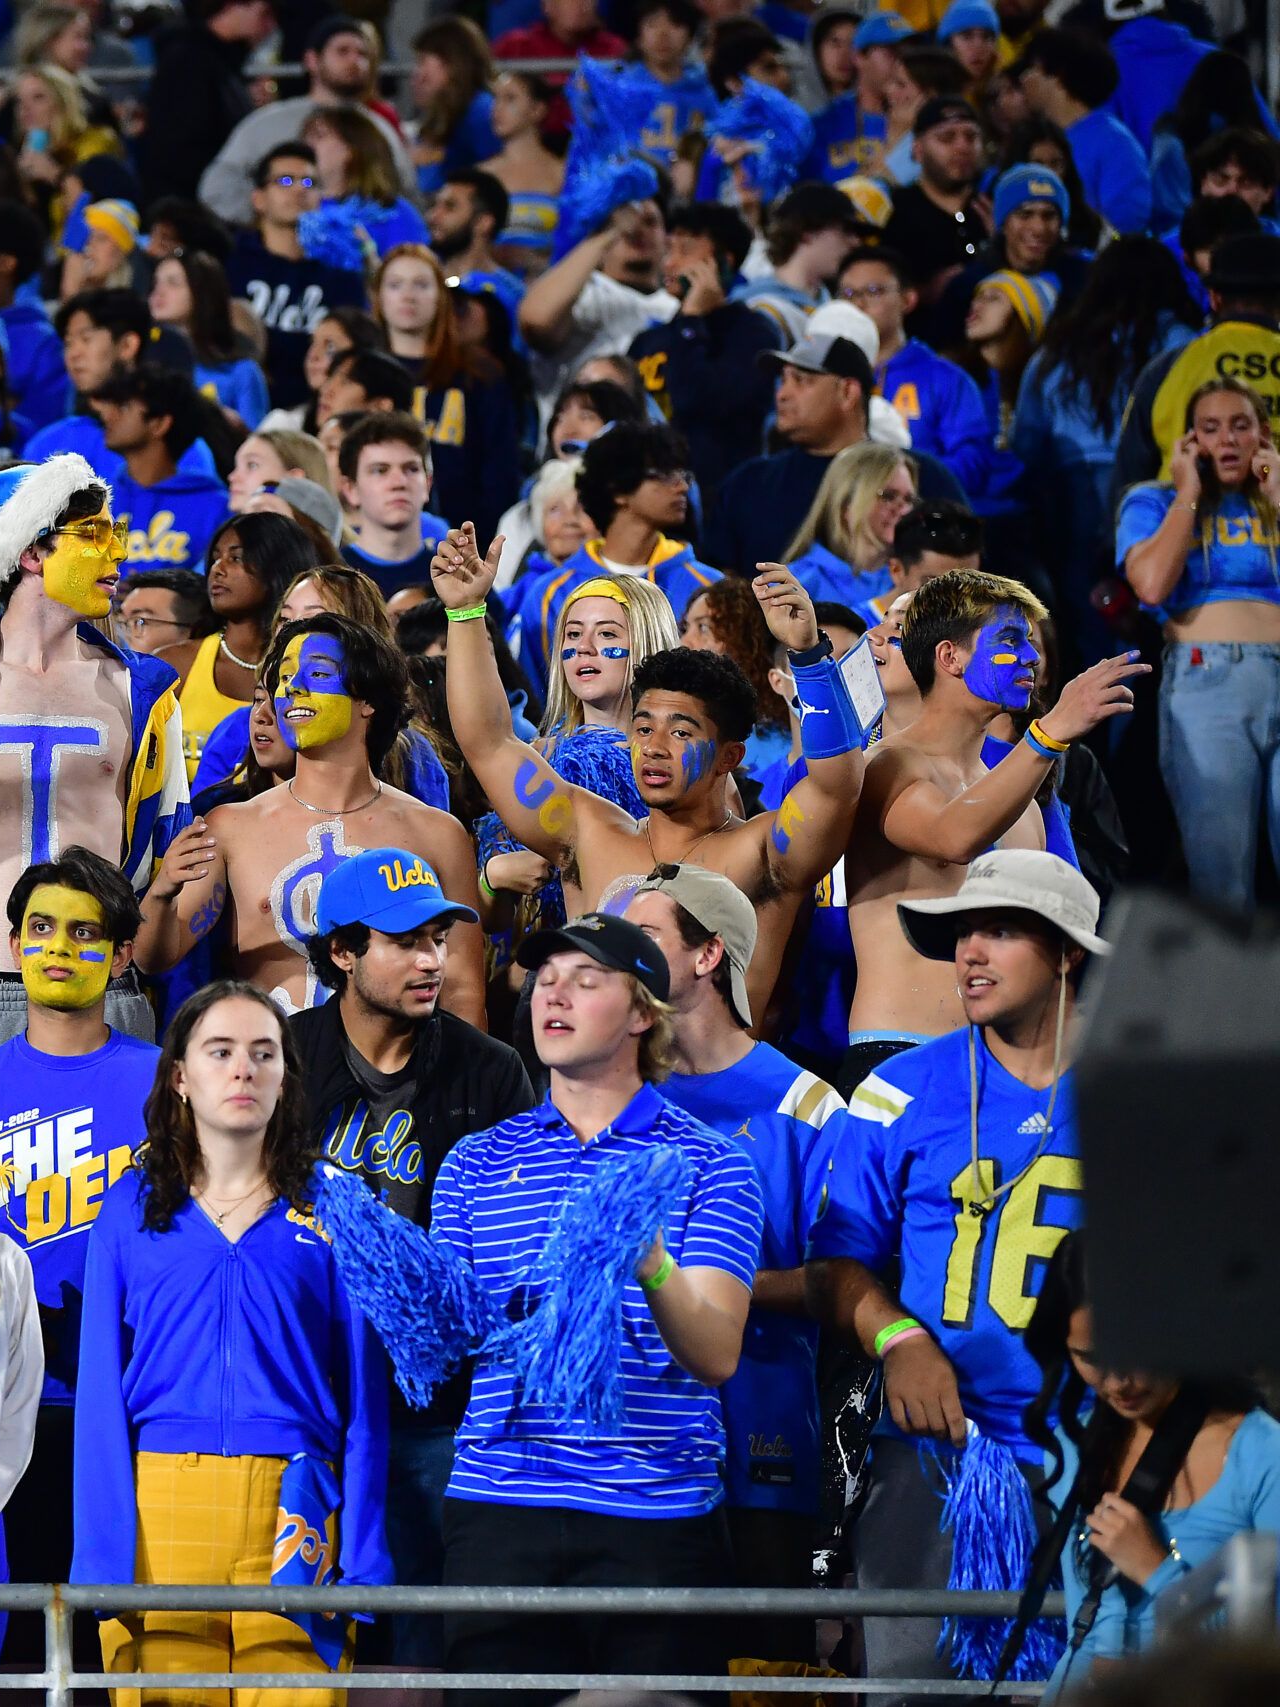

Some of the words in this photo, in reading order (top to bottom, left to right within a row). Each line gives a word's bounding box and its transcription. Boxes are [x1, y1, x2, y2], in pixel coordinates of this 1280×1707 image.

[116, 509, 191, 564] cla
[379, 859, 438, 892] Ucla
[1017, 1125, 1054, 1135] adids
